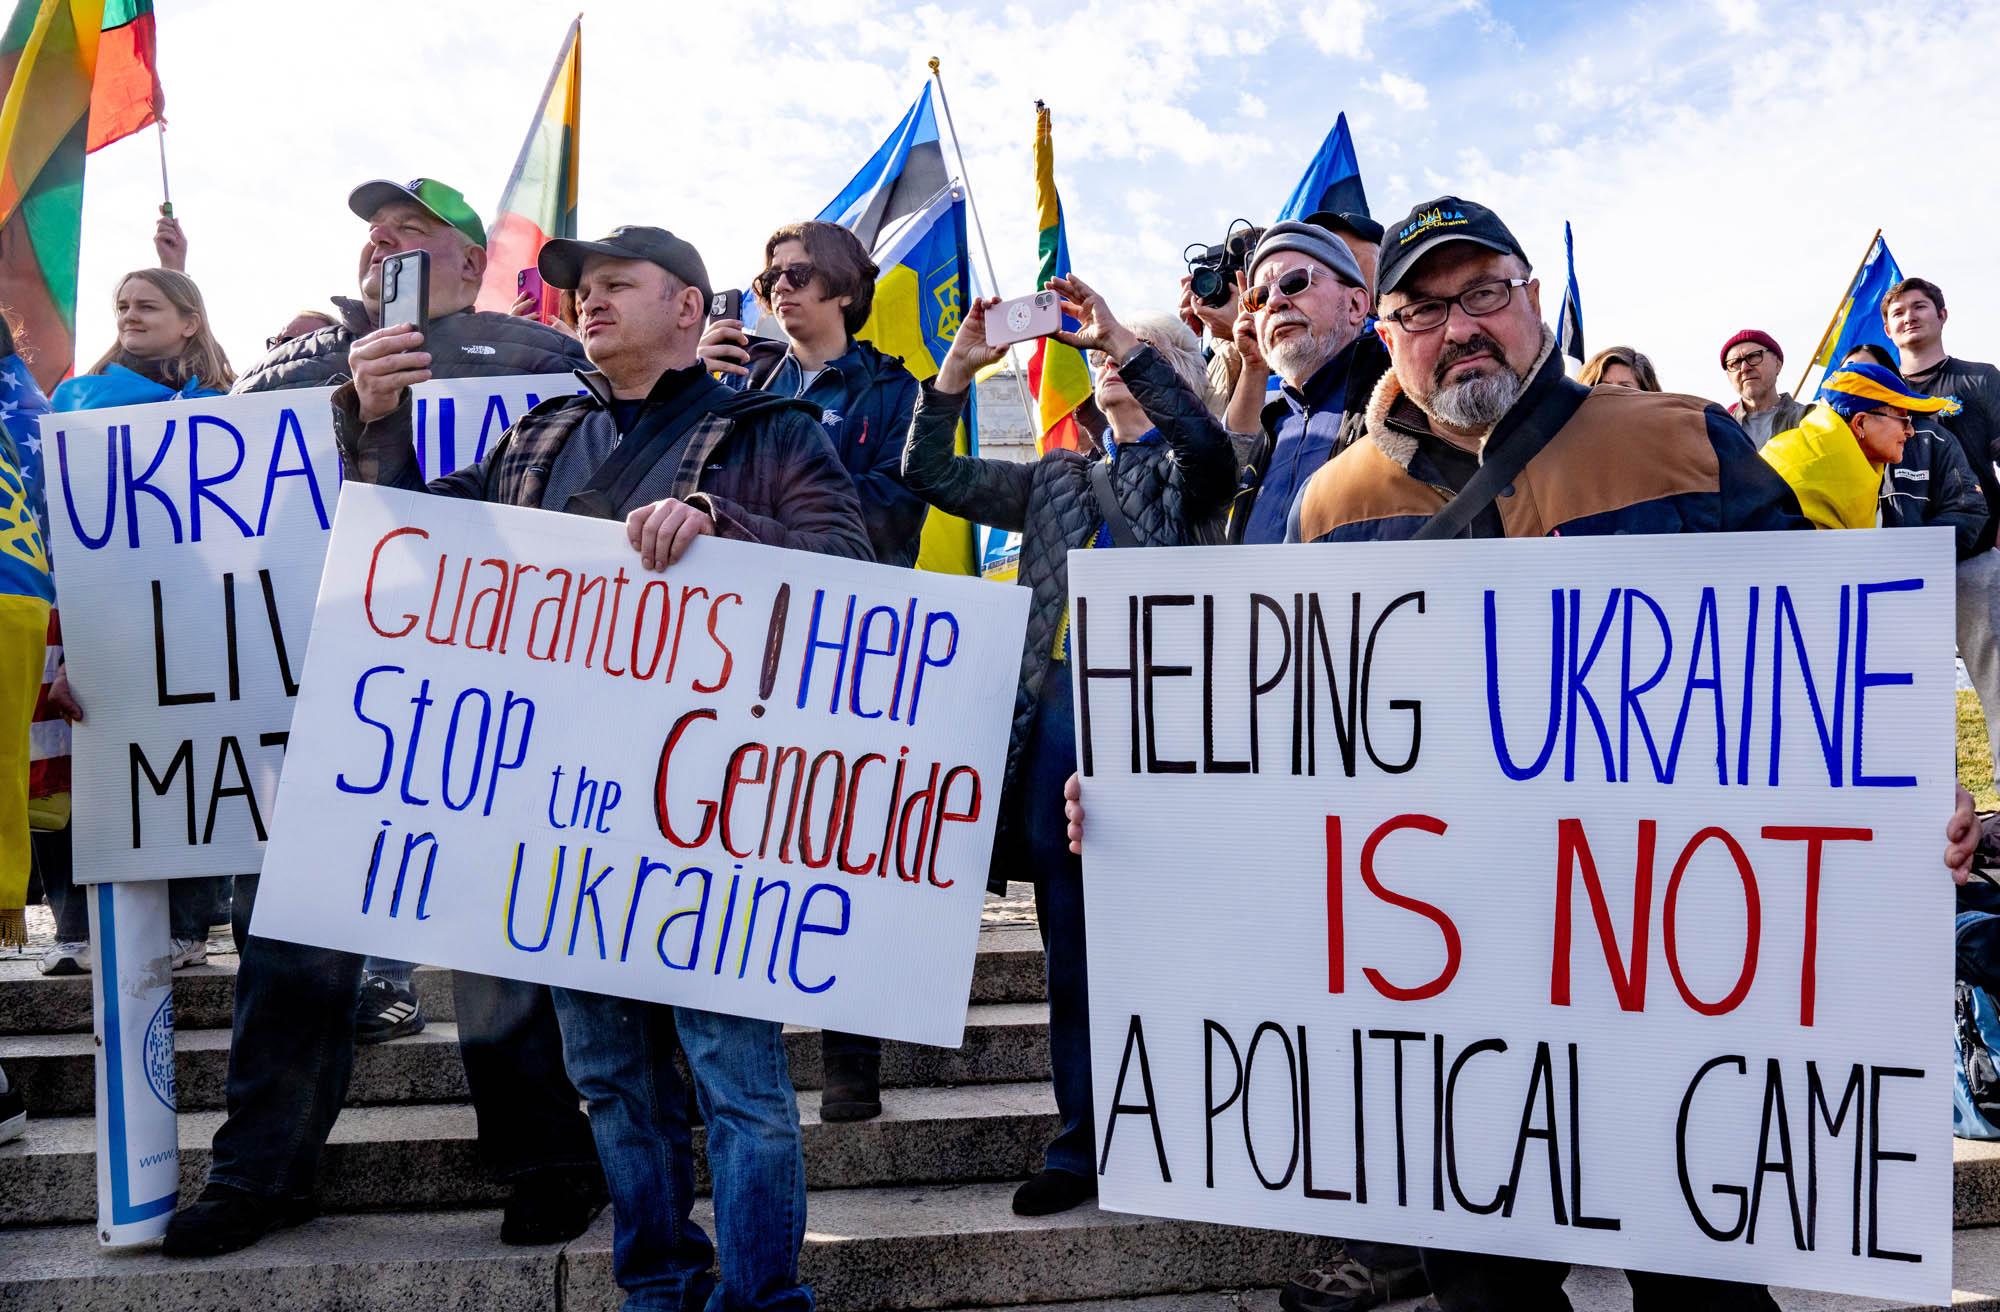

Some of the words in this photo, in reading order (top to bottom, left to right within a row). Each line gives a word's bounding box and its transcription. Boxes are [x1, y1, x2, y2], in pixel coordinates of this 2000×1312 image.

[1442, 211, 1465, 220] UA
[797, 589, 959, 726] Help
[1077, 590, 1426, 777] HELPING
[1484, 578, 1924, 788] UKRAINE
[336, 665, 536, 816] Stop
[549, 765, 622, 834] the
[654, 708, 982, 889] Genocide
[362, 820, 439, 921] in
[504, 842, 851, 994] Ukraine
[1326, 813, 1463, 1002] IS
[1551, 818, 1874, 1028] NOT
[1097, 1014, 1172, 1184] A
[1203, 1018, 1622, 1232] POLITICAL
[1676, 1054, 1925, 1263] GAME
